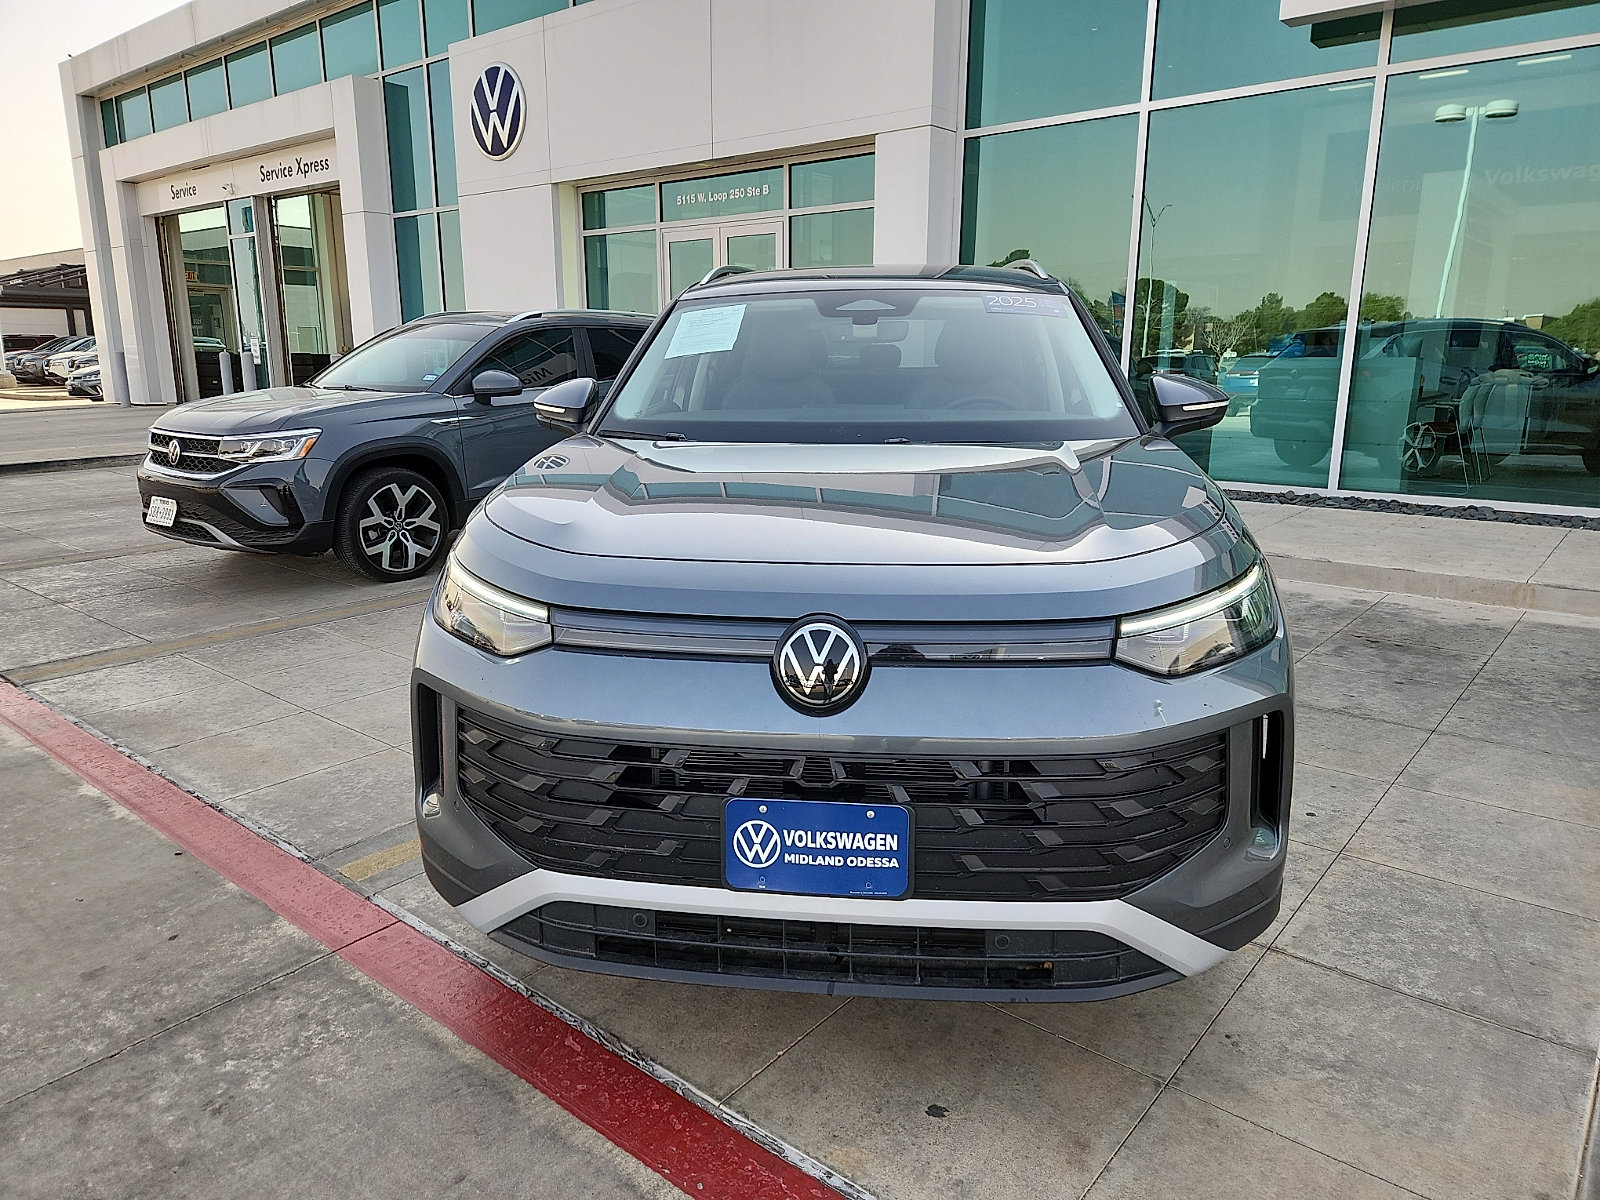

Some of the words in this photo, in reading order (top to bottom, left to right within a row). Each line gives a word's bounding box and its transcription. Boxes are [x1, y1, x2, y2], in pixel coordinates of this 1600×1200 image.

[470, 62, 526, 160] VW
[259, 161, 293, 183] Service
[295, 156, 330, 179] Xpress
[170, 182, 197, 200] Service
[676, 193, 696, 206] 5115
[697, 192, 707, 203] W.
[708, 191, 728, 203] Loop
[729, 188, 745, 199] 250
[746, 186, 761, 197] Ste
[762, 184, 769, 195] B
[986, 295, 1037, 308] 2025
[779, 622, 861, 705] VW
[733, 820, 781, 869] VW
[783, 829, 898, 851] VOLKSWAGEN
[784, 852, 844, 867] MIDLAND
[846, 856, 899, 869] ODESSA
